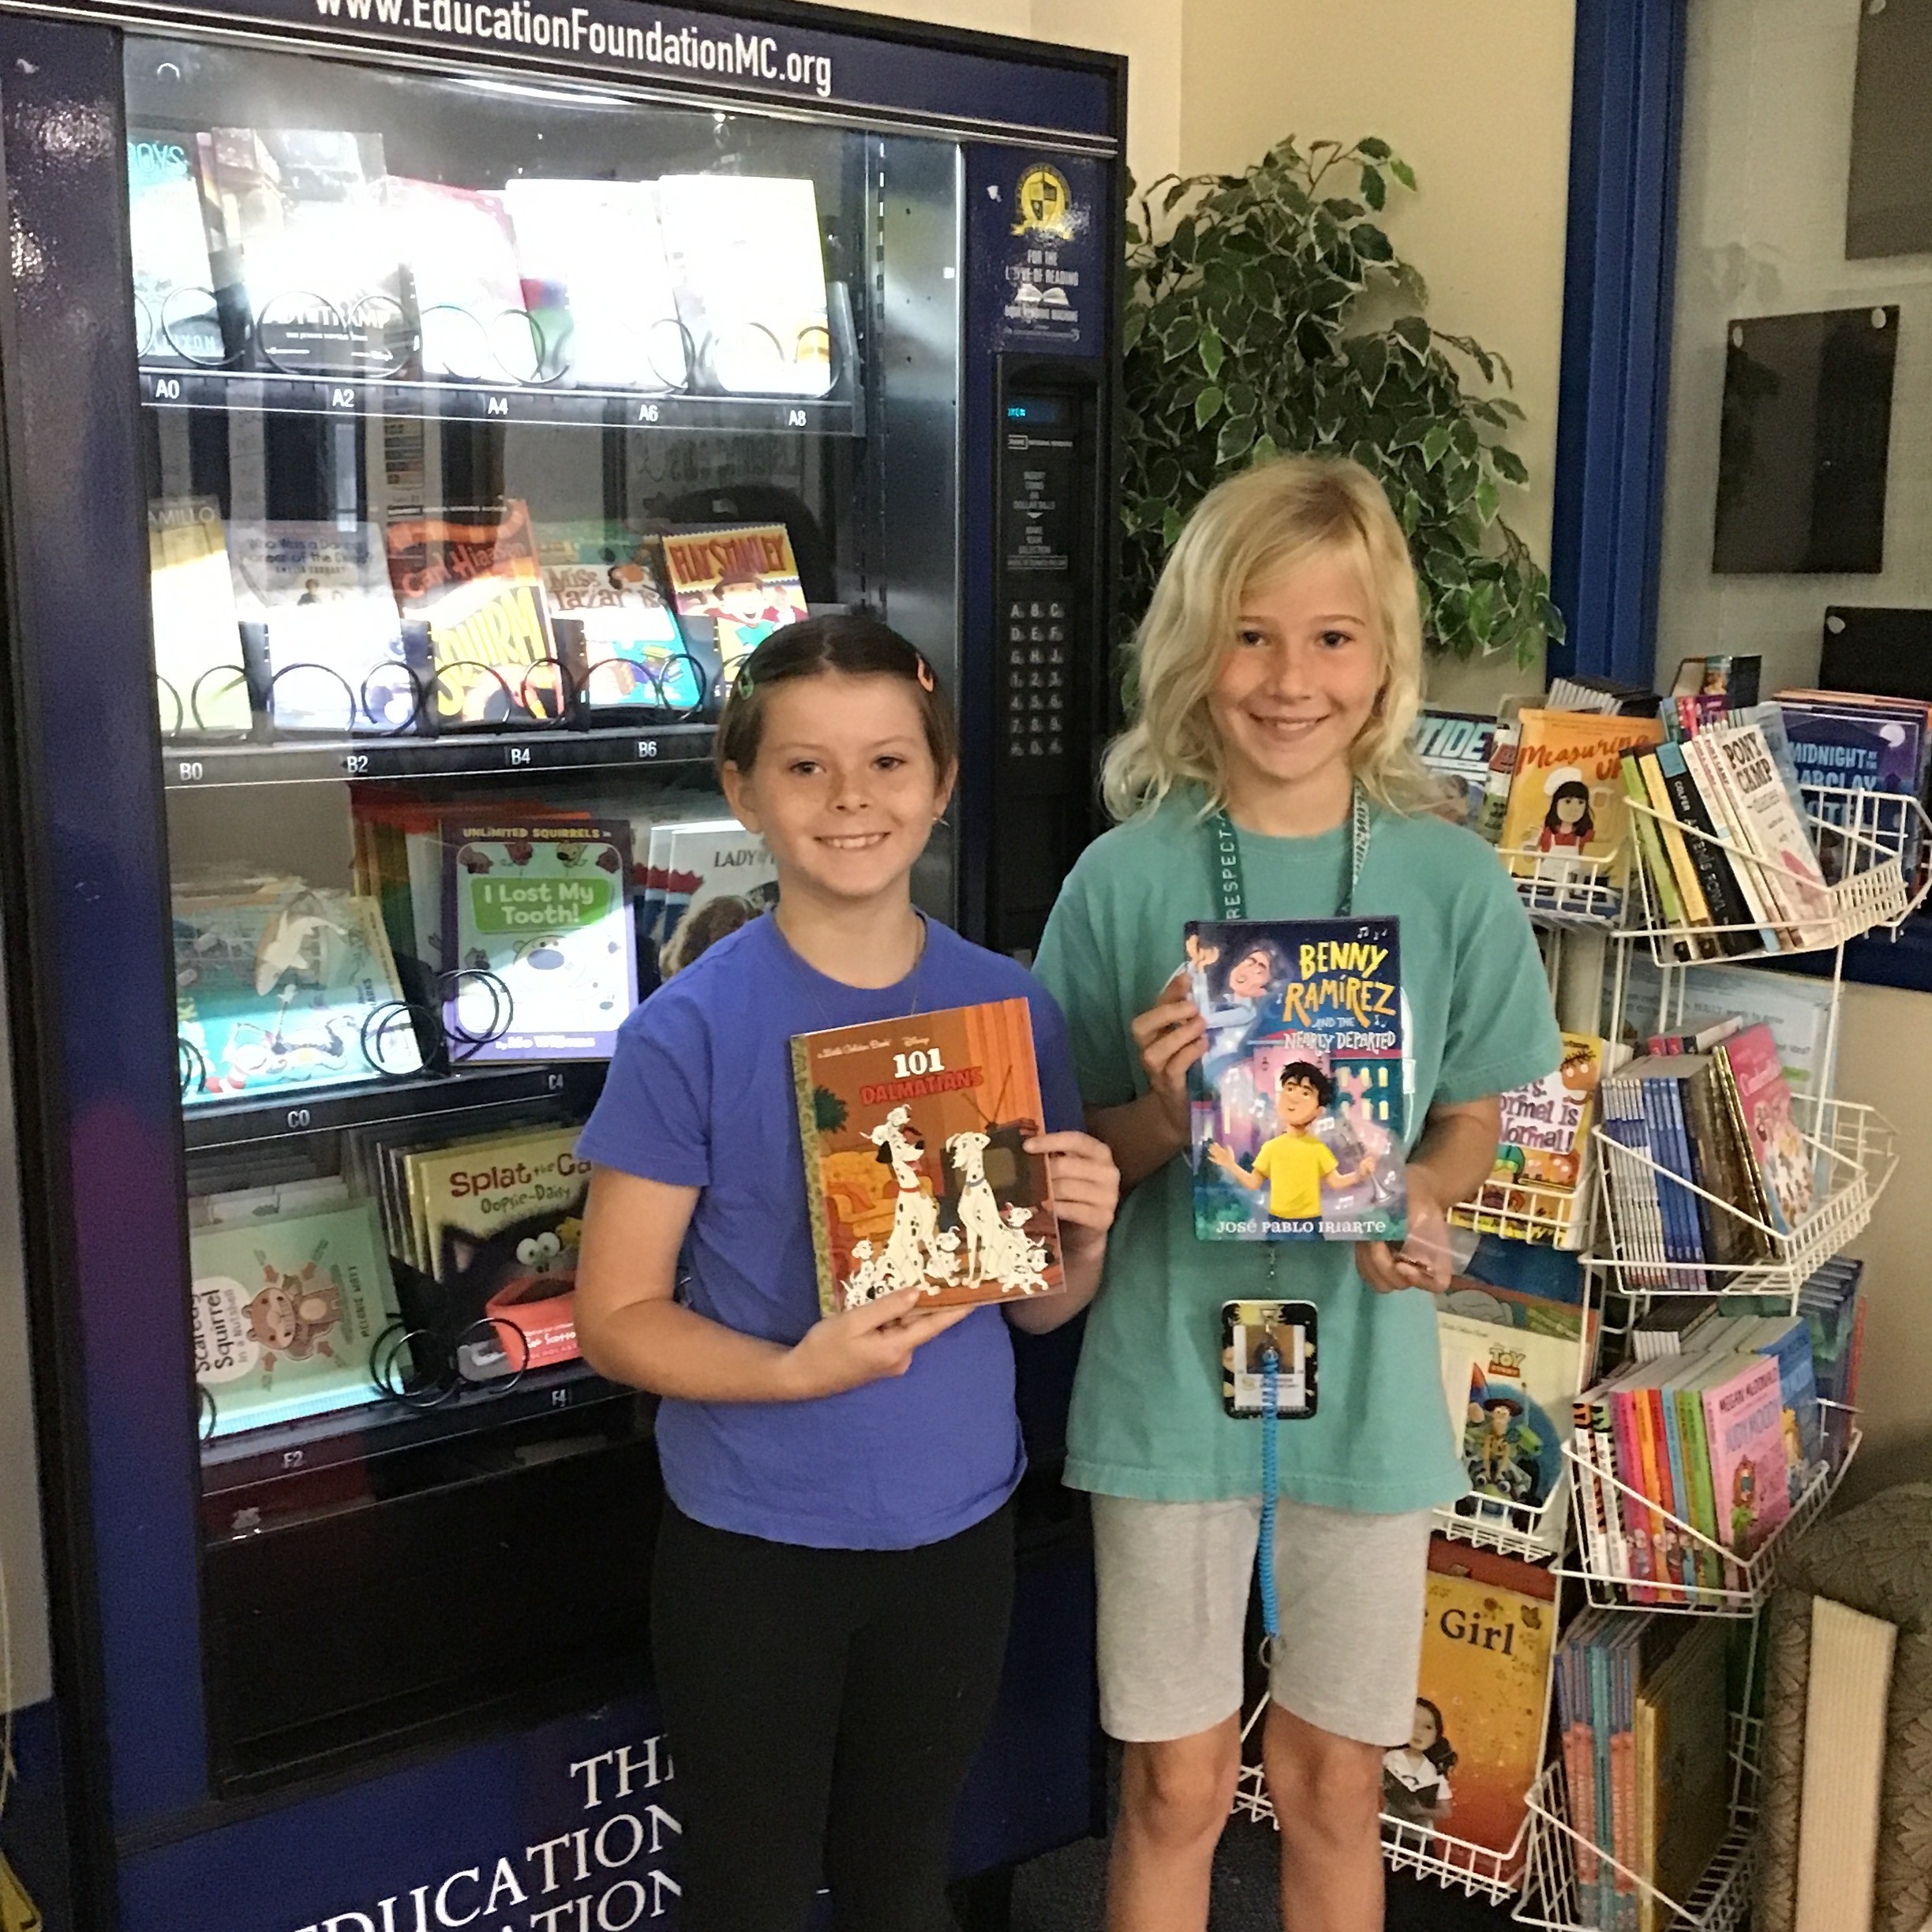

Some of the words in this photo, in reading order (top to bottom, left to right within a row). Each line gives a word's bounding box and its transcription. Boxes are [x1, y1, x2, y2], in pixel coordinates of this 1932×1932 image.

[316, 0, 833, 98] www.EducationFoundationMC.org
[155, 380, 179, 399] A0
[332, 388, 355, 407] A2
[488, 396, 508, 415] A4
[638, 404, 658, 422] A6
[788, 410, 807, 427] A8
[511, 747, 531, 766] B4
[638, 740, 657, 758] B6
[1722, 732, 1762, 769] PONY
[181, 762, 204, 781] B0
[347, 754, 369, 774] B2
[1737, 758, 1773, 794] CAMP
[533, 828, 600, 838] SQUIRRELS
[713, 849, 758, 867] LADY
[1219, 829, 1241, 920] RESPECT
[484, 884, 493, 904] I
[499, 882, 552, 903] Lost
[558, 882, 594, 905] My
[500, 904, 581, 925] Tooth!
[1299, 940, 1389, 981] BENNY
[1336, 1017, 1356, 1028] THE
[1283, 1031, 1335, 1058] NEARLY
[1335, 1031, 1397, 1055] DEPARTED
[893, 1047, 945, 1079] 101
[860, 1066, 985, 1105] DALMATIANS
[287, 1109, 311, 1129] C0
[450, 1163, 532, 1197] Splat
[557, 1153, 592, 1177] Ca
[200, 1288, 234, 1370] Squirrel
[1489, 1346, 1527, 1368] TOY
[284, 1451, 303, 1469] F2
[1440, 1608, 1515, 1656] Girl
[571, 1735, 675, 1809] TH
[295, 1804, 683, 1932] UCATION
